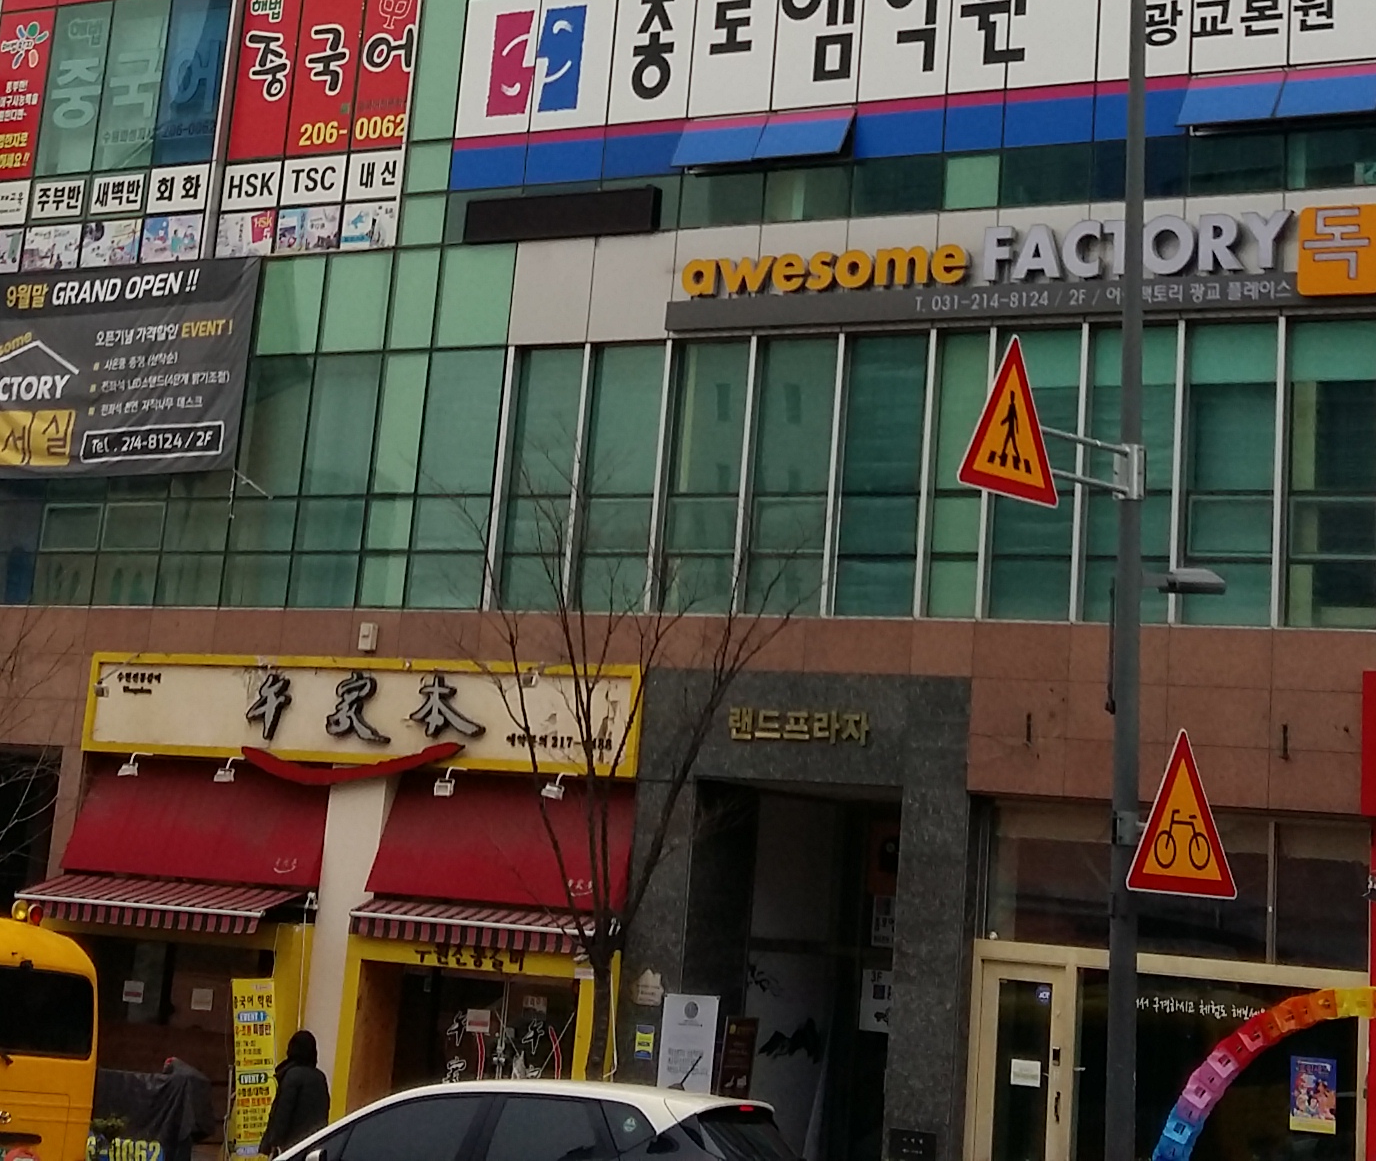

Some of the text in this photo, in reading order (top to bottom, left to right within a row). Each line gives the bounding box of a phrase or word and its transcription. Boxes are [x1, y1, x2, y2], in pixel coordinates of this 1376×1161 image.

[246, 23, 414, 101] 중국어
[299, 114, 406, 146] 206-0062
[37, 184, 81, 213] 주부반
[95, 178, 141, 208] 새벽반
[155, 173, 202, 203] 회화
[227, 171, 276, 200] HSK
[291, 166, 337, 194] TSC
[681, 243, 969, 297] awesome
[984, 209, 1294, 282] FACTORY
[6, 282, 48, 310] 9월말
[52, 276, 122, 306] GRAND
[127, 270, 183, 300] OPEN
[932, 280, 1292, 312] 031-214-8124 2F 광교 플레이스
[95, 319, 226, 347] 오픈기념 가격할인 EVENT
[121, 433, 182, 452] 214-8124
[196, 430, 214, 448] 2F
[728, 706, 870, 747] 랜드프라자
